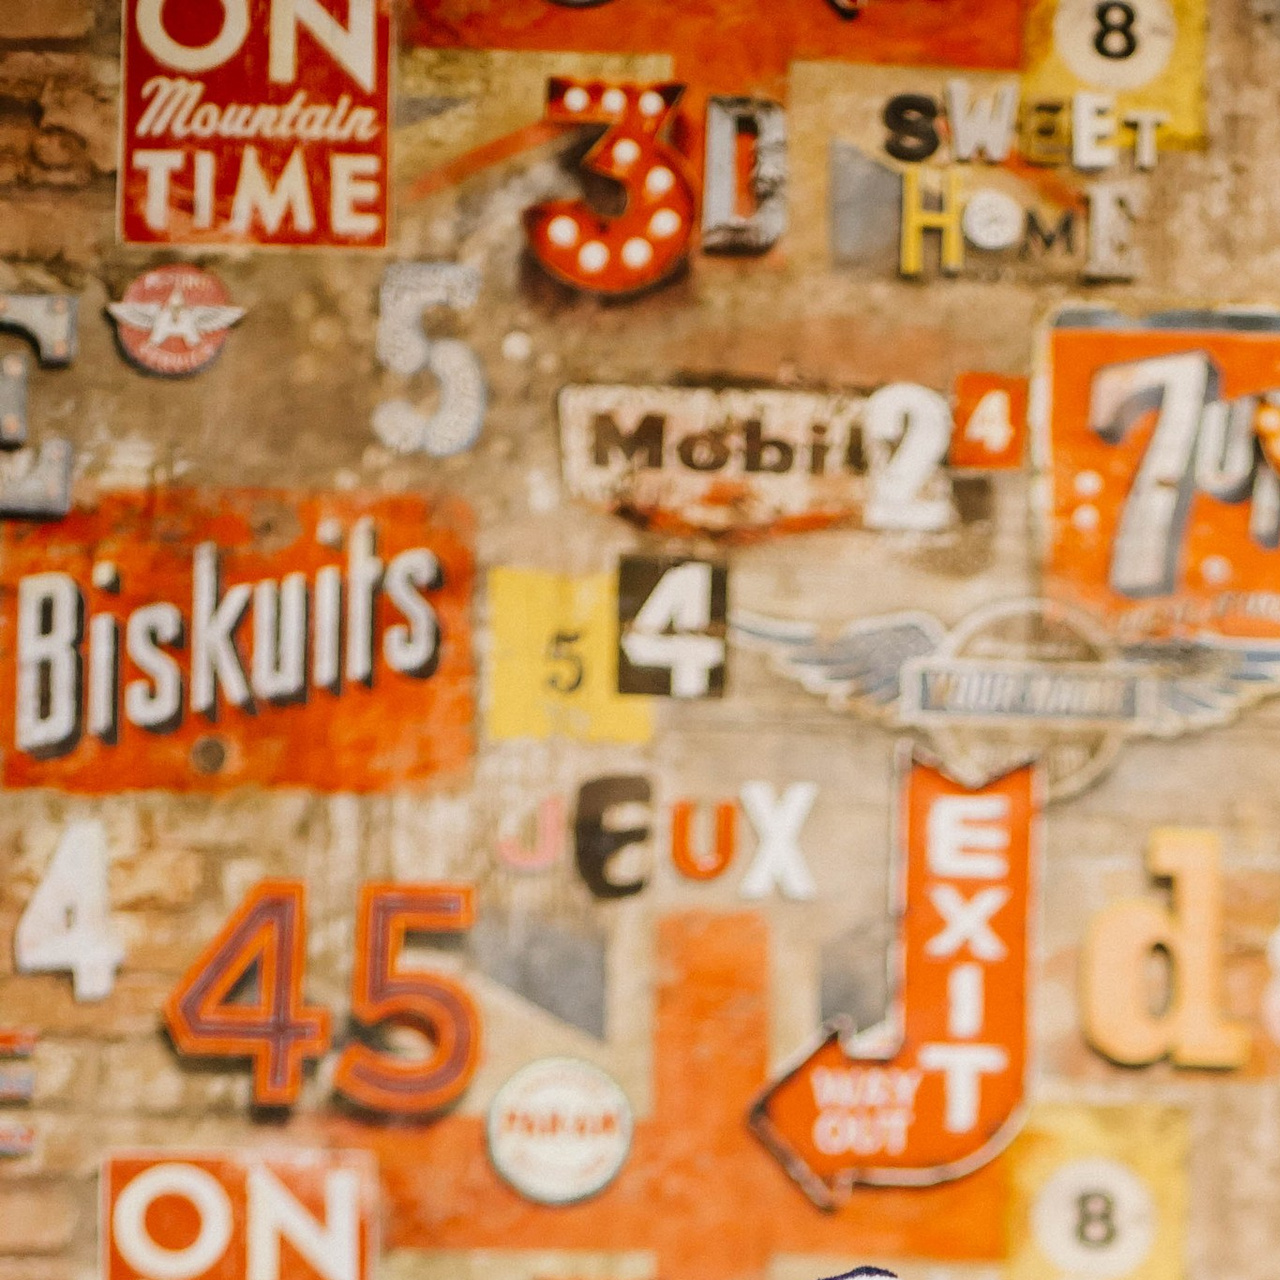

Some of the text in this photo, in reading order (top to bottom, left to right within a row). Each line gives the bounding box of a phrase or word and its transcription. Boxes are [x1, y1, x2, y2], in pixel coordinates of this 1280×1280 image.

[136, 0, 377, 94] ON
[1092, 0, 1137, 61] 8
[136, 76, 380, 141] Mountain
[883, 80, 1170, 171] SWEET
[132, 150, 381, 237] TIME
[373, 262, 487, 456] 5
[863, 383, 952, 531] 2
[964, 388, 1014, 452] 4
[15, 515, 443, 760] Biskuits
[545, 632, 587, 693] 5
[622, 562, 722, 698] 4
[16, 819, 125, 1002] 4
[1086, 828, 1252, 1069] d
[163, 878, 482, 1118] 45
[921, 796, 1011, 1133] EXIT
[811, 1066, 922, 1108] WAY
[812, 1109, 912, 1156] OUT
[1074, 1190, 1119, 1251] 8
